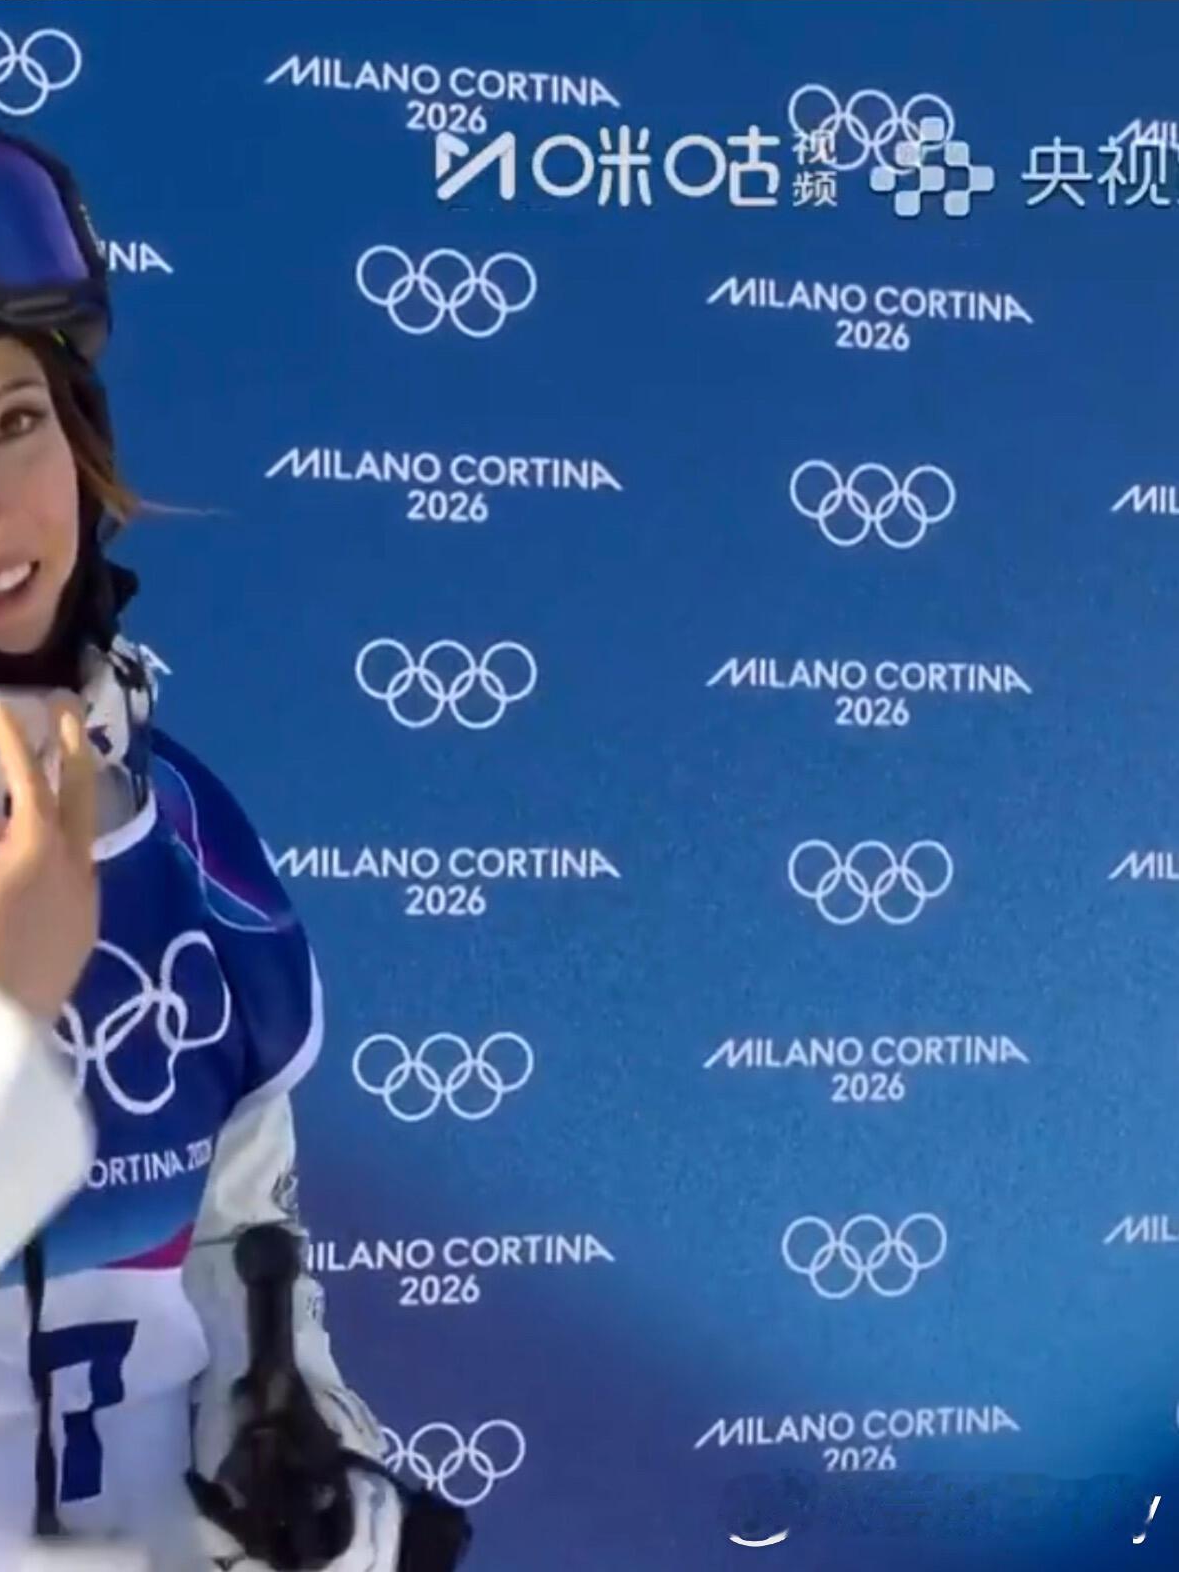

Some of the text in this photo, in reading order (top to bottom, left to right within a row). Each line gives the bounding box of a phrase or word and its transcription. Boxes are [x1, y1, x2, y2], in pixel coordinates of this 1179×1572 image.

[265, 55, 621, 108] MILANO CORTINA
[406, 99, 487, 134] 2026
[707, 276, 1033, 324] MILANO CORTINA
[836, 318, 910, 352] 2026
[265, 447, 623, 491] MILANO CORTINA
[407, 489, 489, 523] 2026
[706, 657, 1032, 694] MILANO CORTINA
[835, 695, 910, 727] 2026
[274, 847, 621, 879] MILANO CORTINA
[405, 884, 487, 916] 2026
[703, 1035, 1029, 1069] MILANO CORTINA
[831, 1071, 906, 1103] 2026
[87, 1148, 185, 1189] ORTINA
[306, 1233, 615, 1270] ILANO CORTINA
[399, 1274, 481, 1306] 2026
[694, 1405, 1020, 1449] MILANO CORTINA
